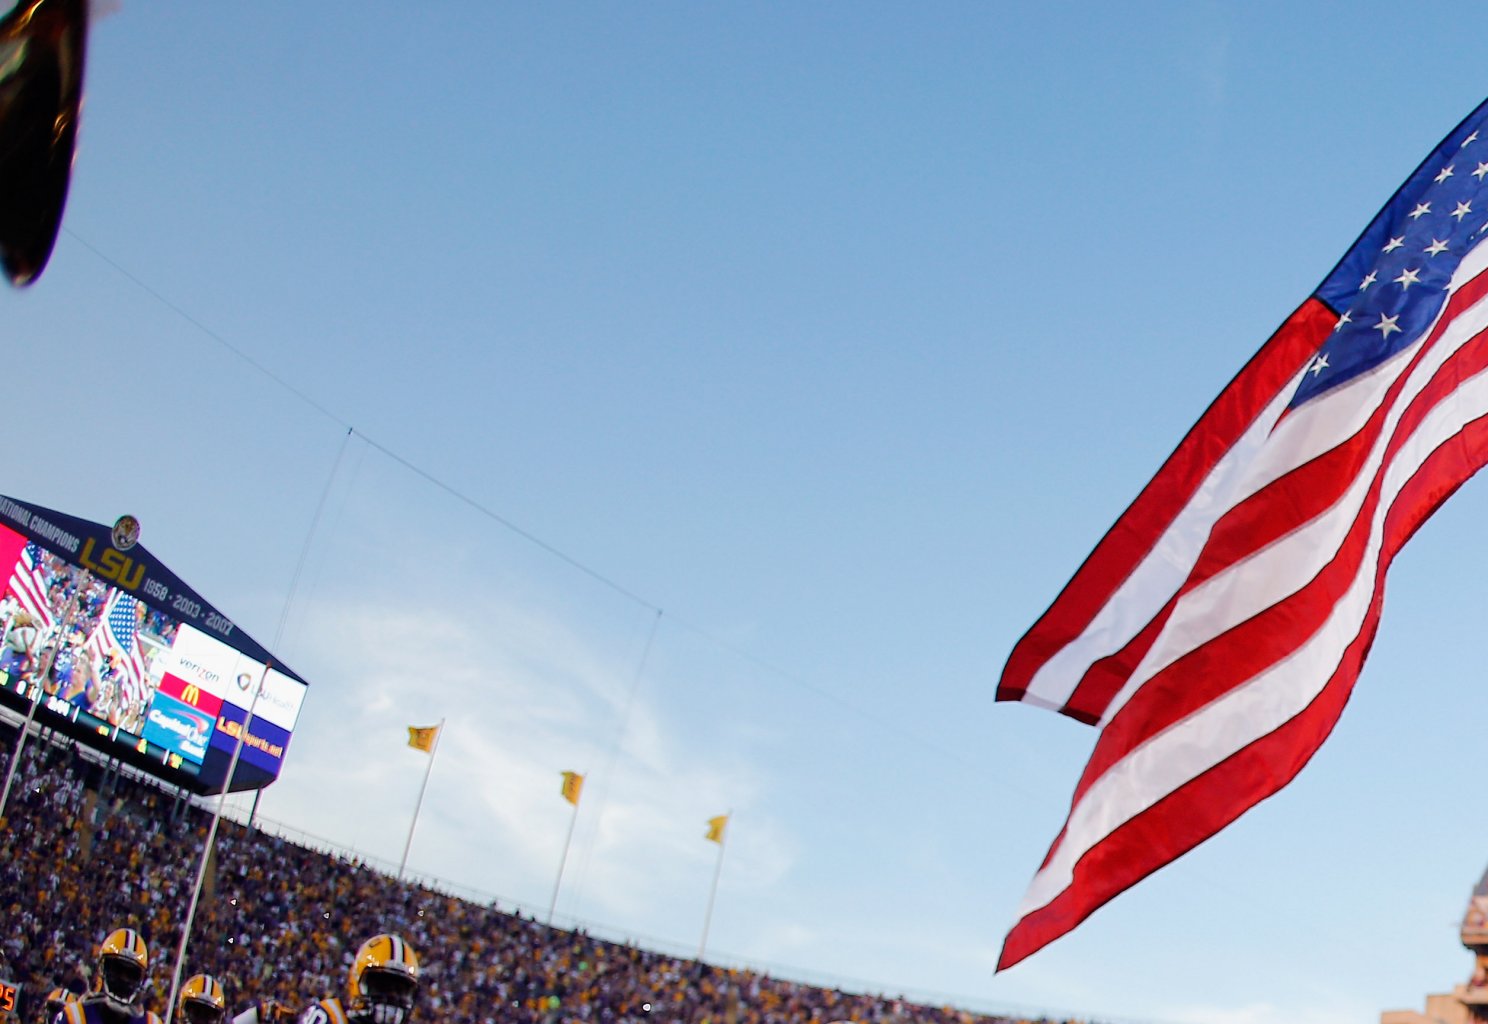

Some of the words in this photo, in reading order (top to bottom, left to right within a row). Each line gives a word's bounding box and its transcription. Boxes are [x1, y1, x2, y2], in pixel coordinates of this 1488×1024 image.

[30, 515, 80, 554] CHAMPIONS
[79, 537, 147, 591] LSU
[144, 578, 169, 601] 1958
[172, 593, 202, 619] 2003
[205, 611, 235, 637] 2007
[179, 656, 221, 683] verizon
